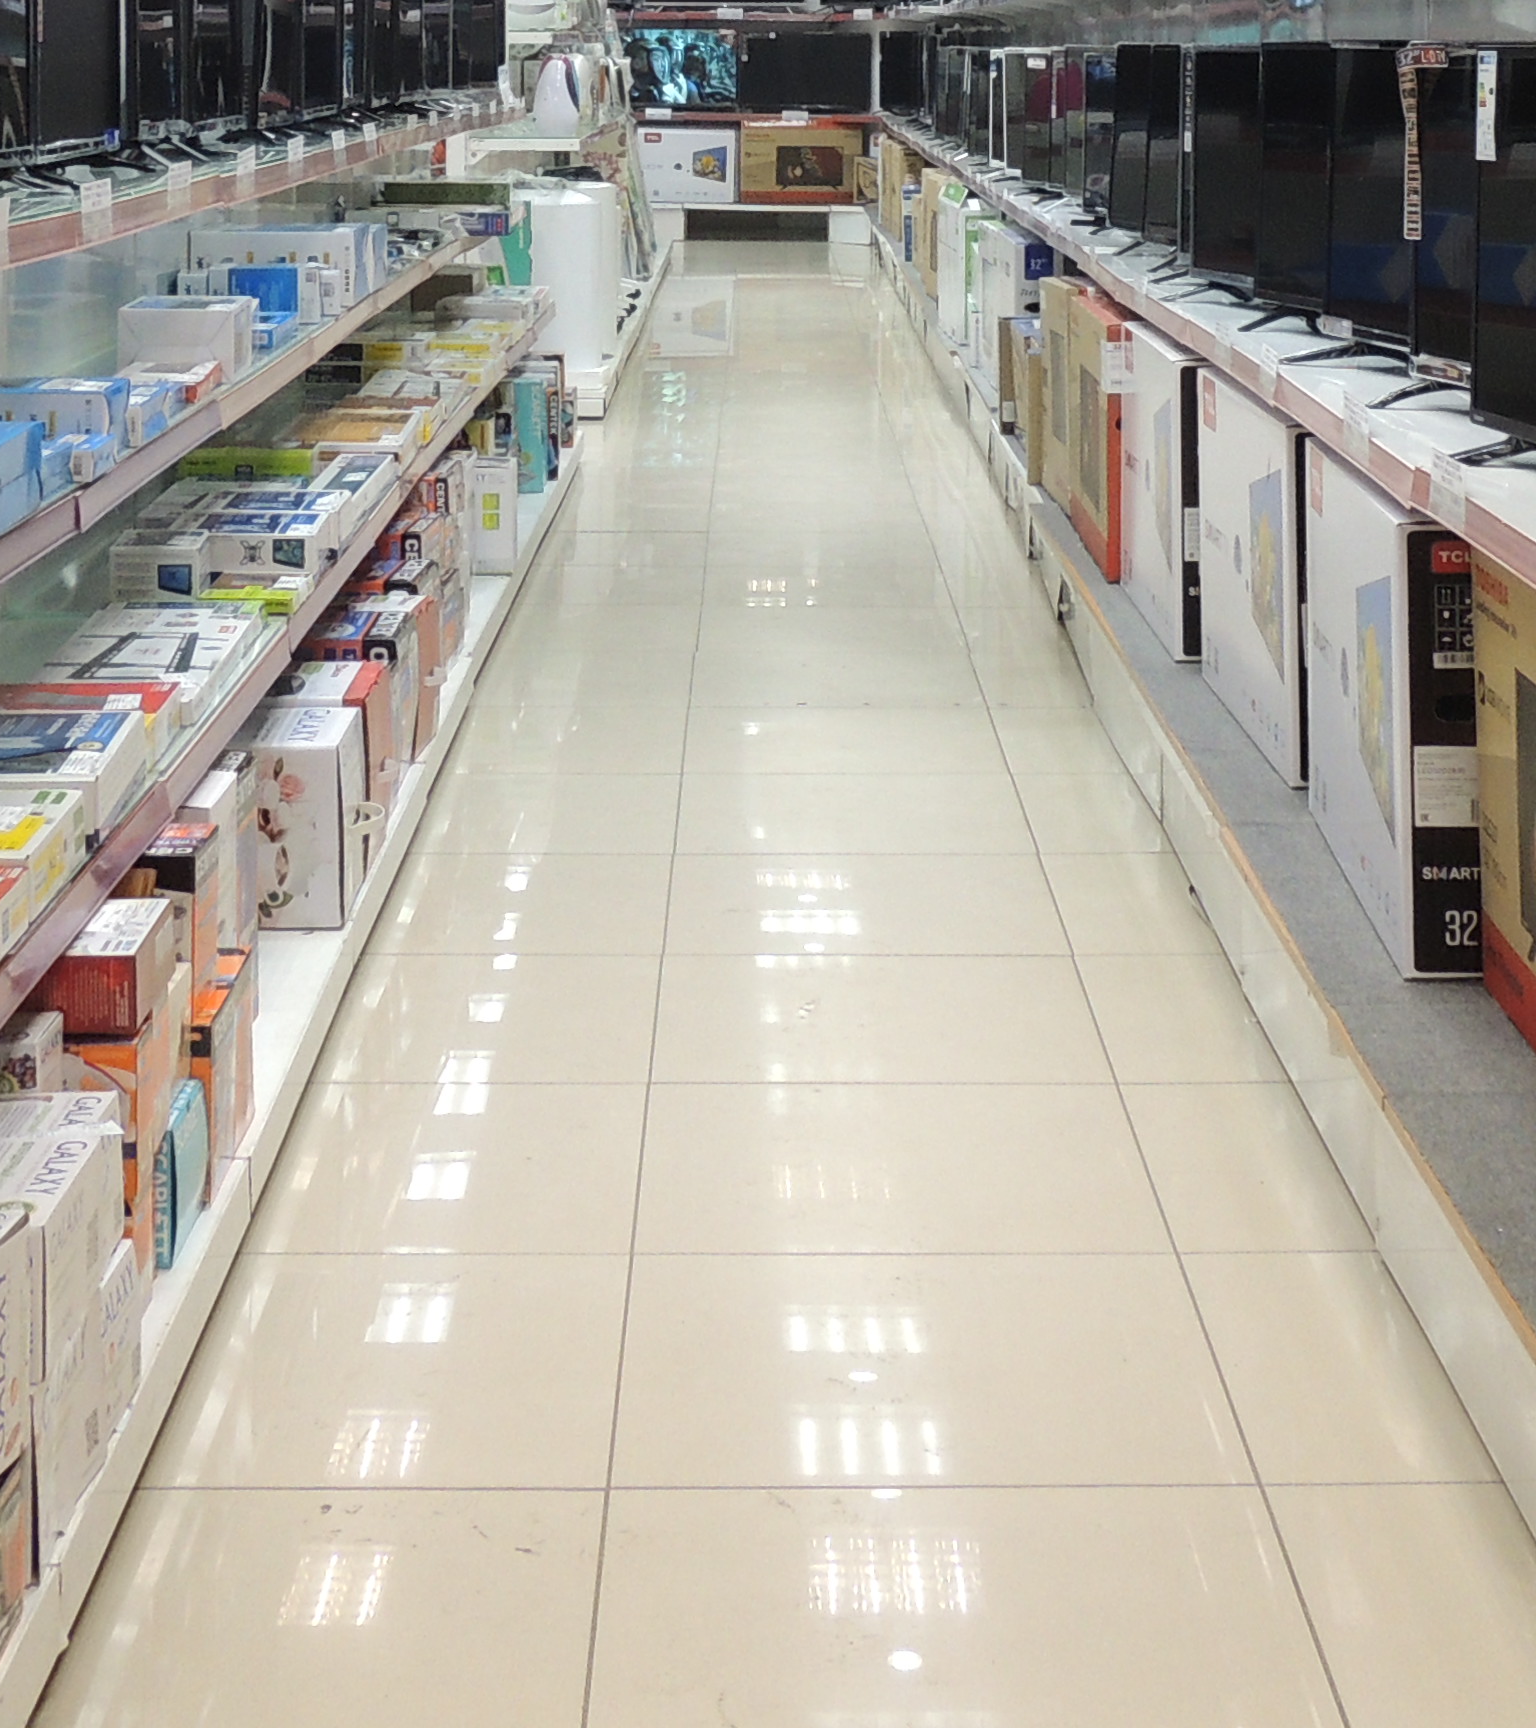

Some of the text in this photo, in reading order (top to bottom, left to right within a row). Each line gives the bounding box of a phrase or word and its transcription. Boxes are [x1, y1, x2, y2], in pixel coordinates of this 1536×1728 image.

[549, 394, 559, 437] CENTEK
[435, 481, 445, 515] CENT
[289, 709, 331, 743] GALAXY
[1422, 867, 1480, 881] SMART
[1445, 910, 1479, 947] 32
[57, 1096, 102, 1129] GALA
[26, 1139, 88, 1197] GALAXY
